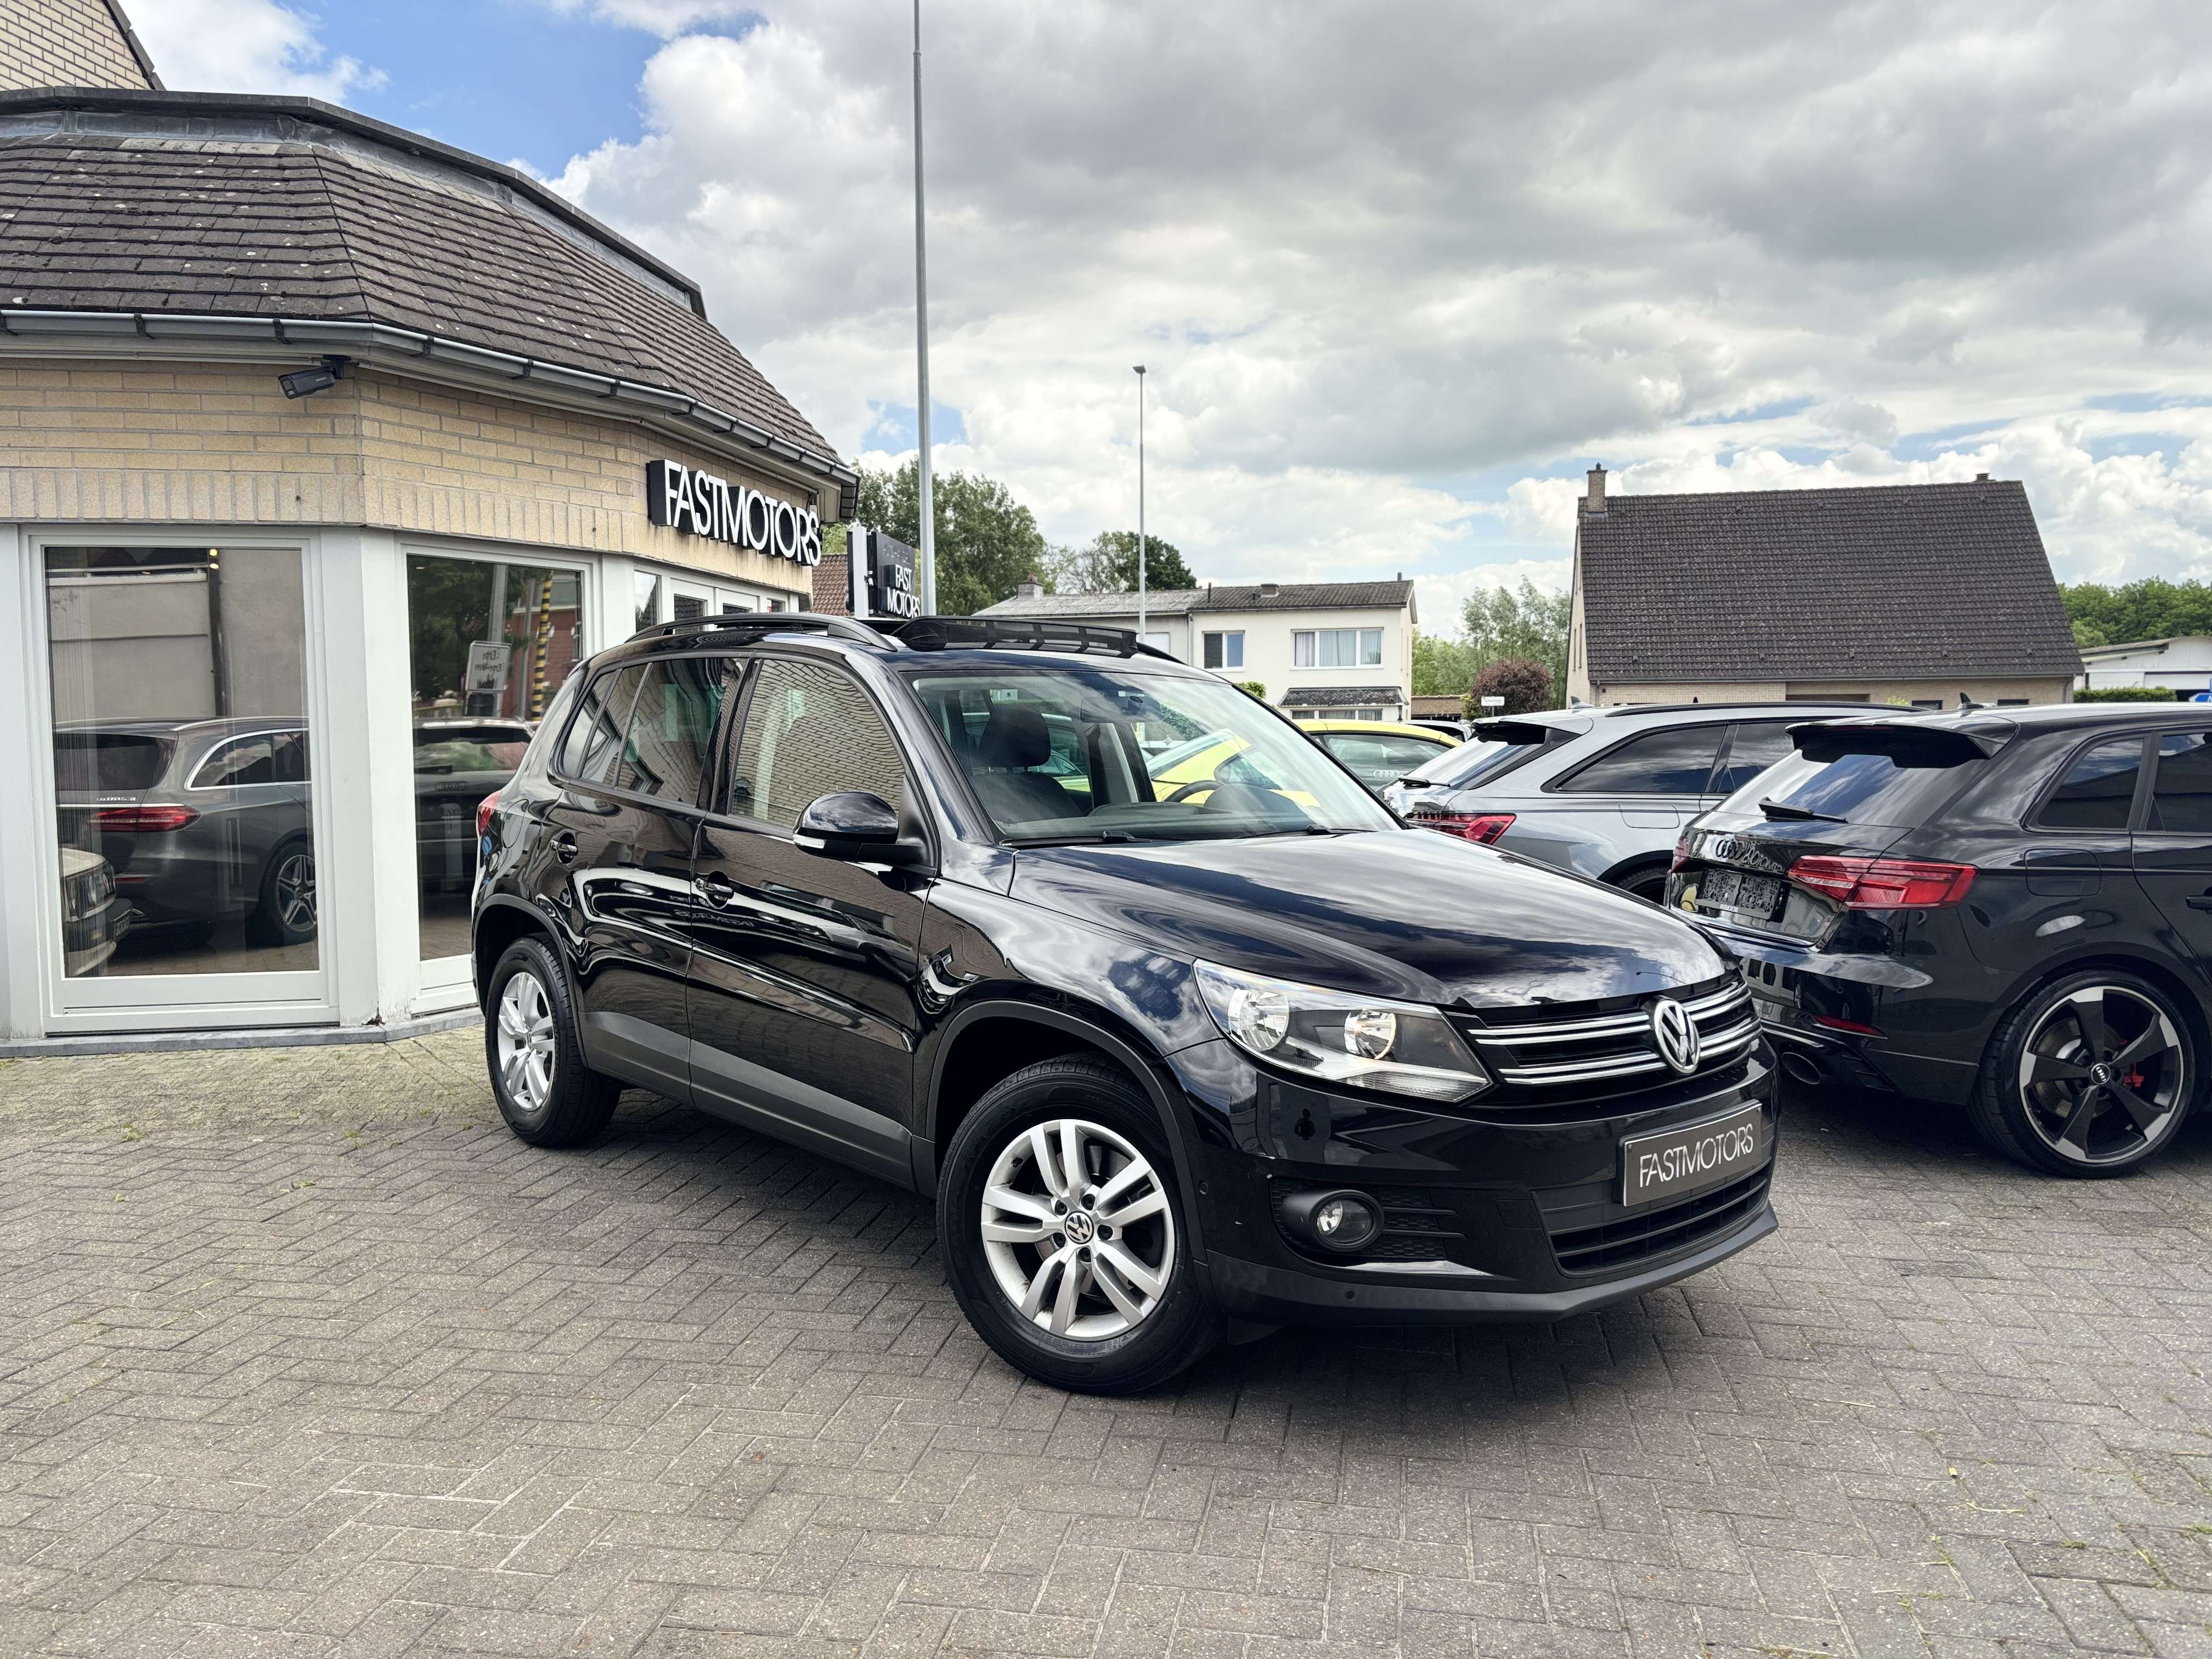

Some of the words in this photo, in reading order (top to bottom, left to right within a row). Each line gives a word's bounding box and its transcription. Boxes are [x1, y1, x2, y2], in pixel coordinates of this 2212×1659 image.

[664, 459, 821, 567] FASTMOTORS
[887, 586, 921, 619] MOTORS
[895, 564, 912, 592] FAST
[1639, 1122, 1754, 1188] FASTMOTORS
